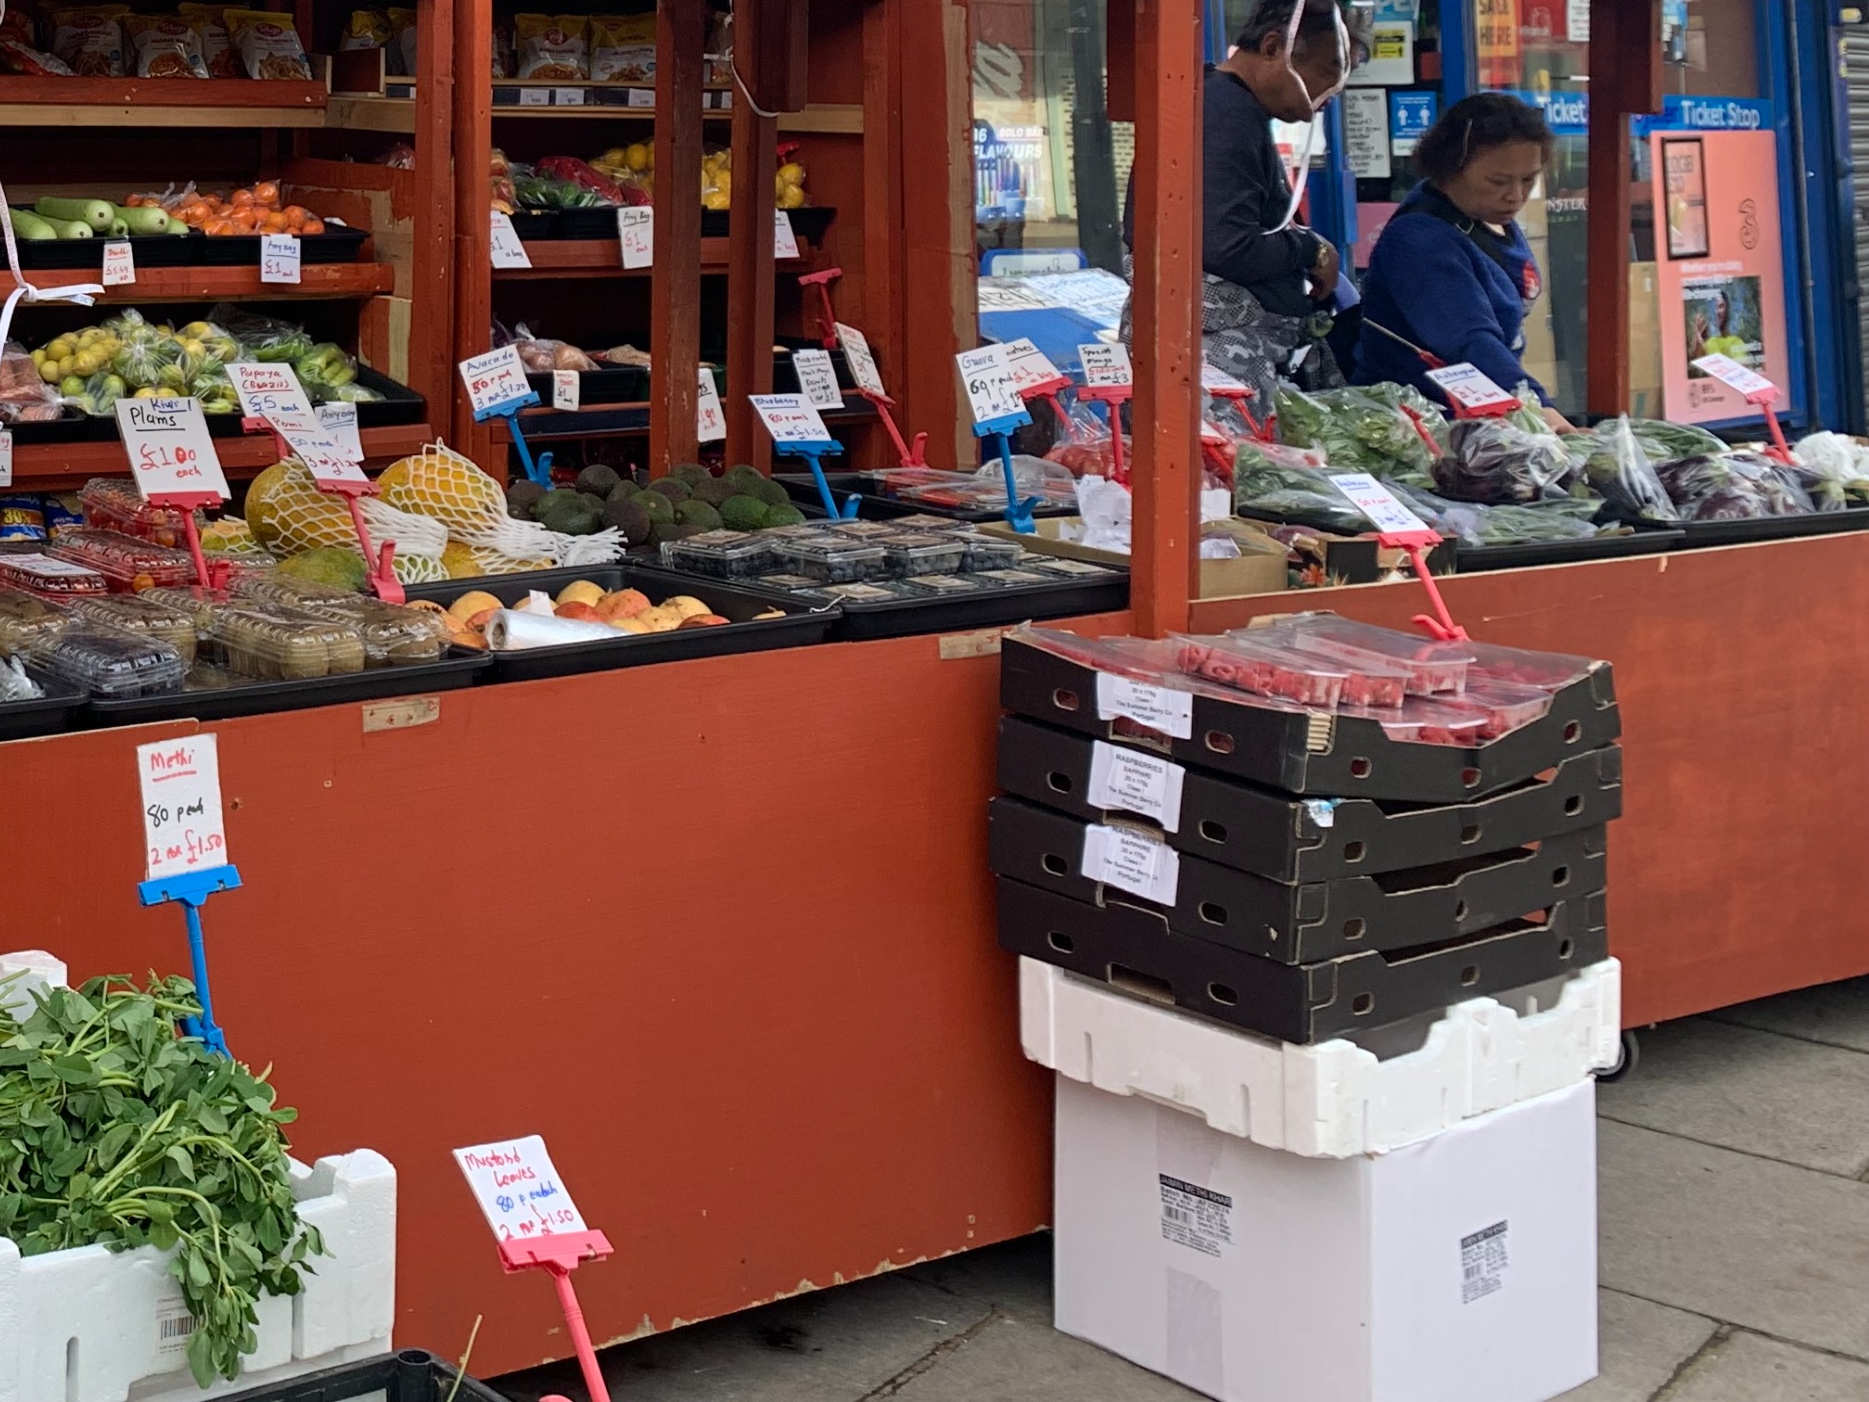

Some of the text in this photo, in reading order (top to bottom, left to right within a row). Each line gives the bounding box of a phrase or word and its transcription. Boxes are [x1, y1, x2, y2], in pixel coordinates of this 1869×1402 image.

[1479, 26, 1512, 45] HERE
[1681, 100, 1761, 130] Ticket Stop
[999, 126, 1024, 138] SOLO
[1546, 196, 1588, 213] NSTER
[961, 353, 995, 369] Guava
[248, 394, 277, 413] £5
[975, 405, 990, 419] 2
[176, 464, 203, 479] each
[1115, 700, 1126, 708] The
[1126, 702, 1149, 712] Summer
[1149, 706, 1165, 715] Berry
[1131, 711, 1156, 722] Portugal
[150, 746, 195, 772] Methi
[1115, 753, 1164, 774] RASPBERRIES
[1117, 789, 1139, 800] Summer
[147, 802, 169, 828] 80
[150, 847, 162, 865] 2
[185, 828, 223, 865] £1.50
[1114, 861, 1136, 873] Summer
[493, 1165, 537, 1188] Leaves
[495, 1194, 515, 1213] 80
[498, 1223, 515, 1241] 2
[530, 1202, 575, 1236] £1.50
